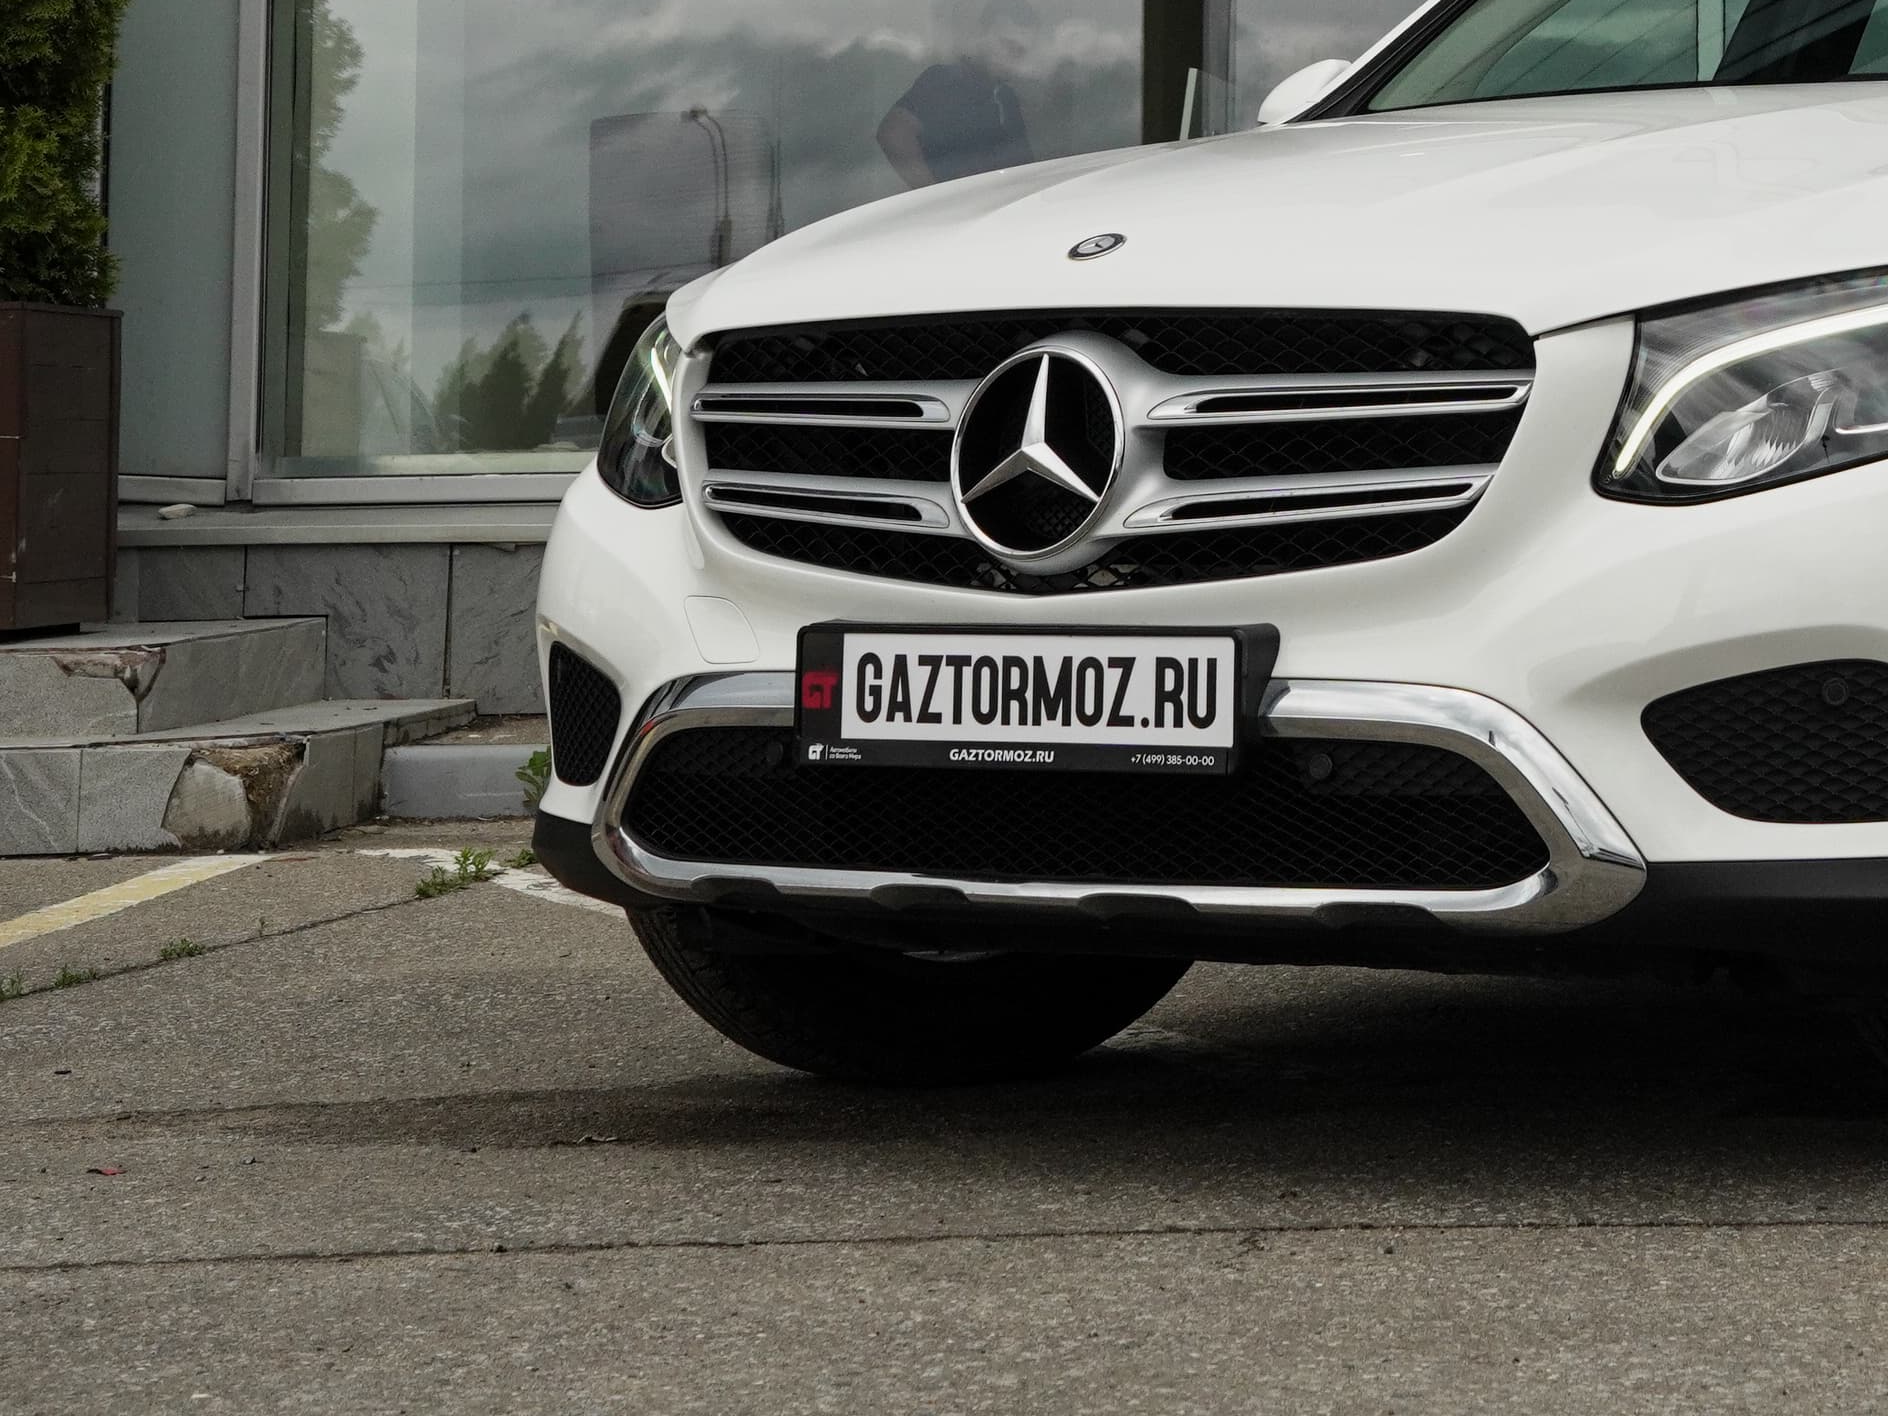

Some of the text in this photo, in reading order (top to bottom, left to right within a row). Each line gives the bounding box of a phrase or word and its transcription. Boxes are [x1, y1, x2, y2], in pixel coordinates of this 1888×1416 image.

[855, 652, 1217, 730] GAZTORMOZ.RU
[949, 748, 1055, 764] GAZTORMOZ.RU
[1131, 753, 1215, 766] +7 (499) 385-00-00
